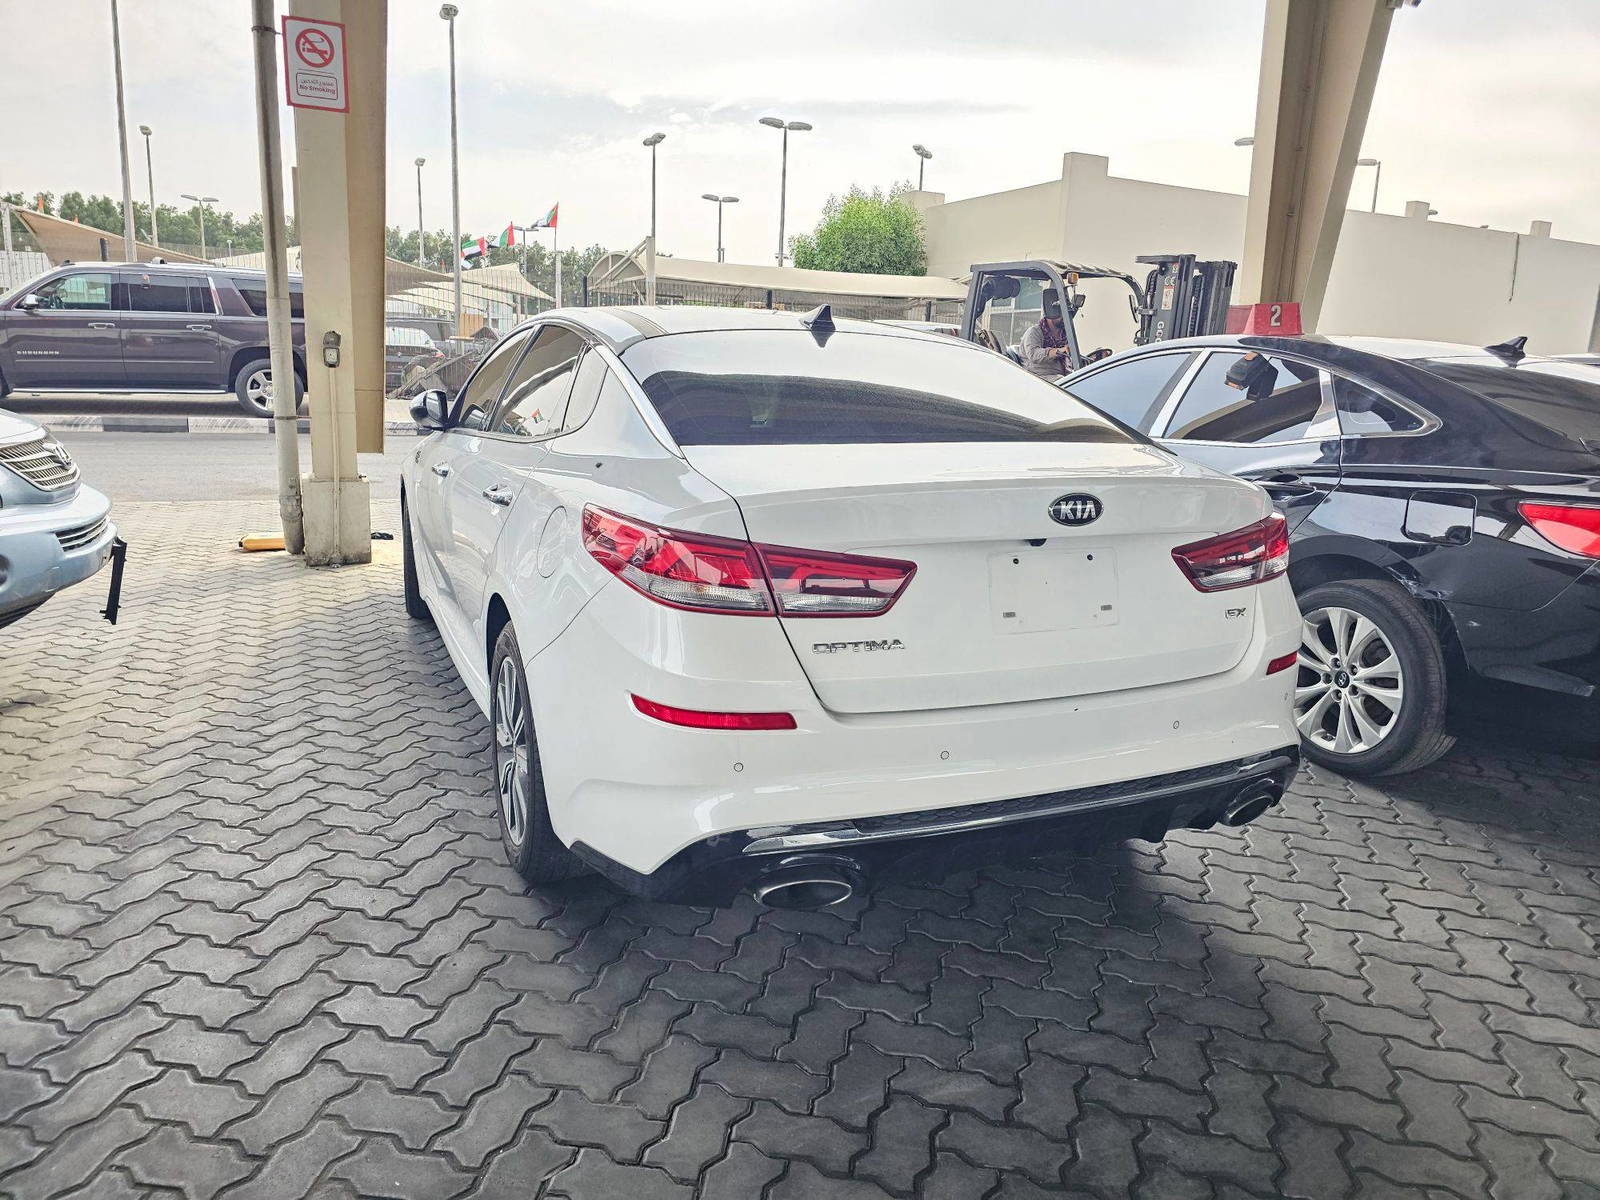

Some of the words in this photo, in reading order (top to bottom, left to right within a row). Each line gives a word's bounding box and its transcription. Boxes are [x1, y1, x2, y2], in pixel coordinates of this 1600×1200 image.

[309, 85, 336, 95] Smoking
[1270, 304, 1281, 327] 2
[1059, 500, 1097, 520] KIA
[1225, 607, 1247, 619] EX
[812, 638, 905, 654] OPTIMA
